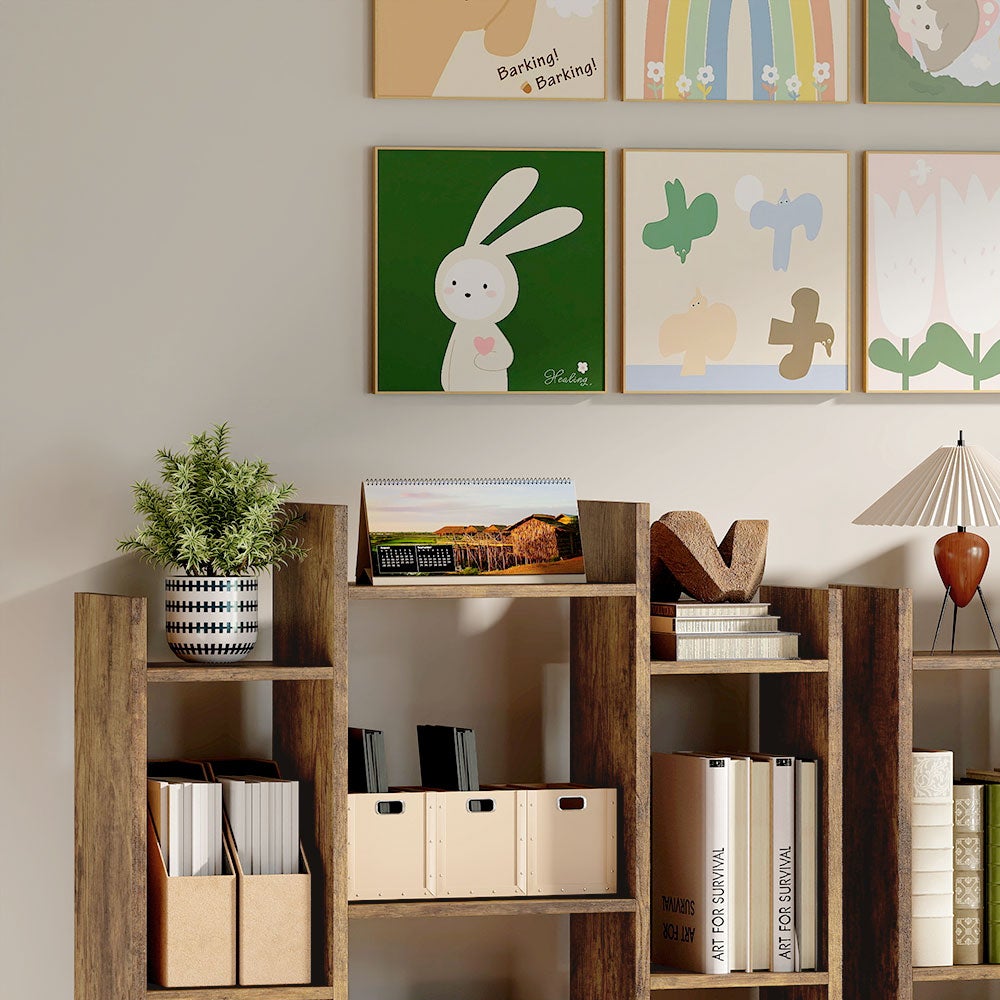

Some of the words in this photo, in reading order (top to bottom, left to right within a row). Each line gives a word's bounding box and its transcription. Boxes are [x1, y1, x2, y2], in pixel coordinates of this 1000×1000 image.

[497, 48, 559, 80] Barking!
[535, 57, 597, 90] Barking!
[712, 847, 725, 904] SURVIVAL
[779, 846, 791, 902] SURVIVAL
[662, 895, 695, 916] SURVIVAL
[662, 922, 678, 942] FOR
[712, 908, 725, 934] FOR
[779, 906, 791, 932] FOR
[681, 927, 696, 943] ART
[712, 938, 725, 962] ART
[779, 937, 791, 960] ART
